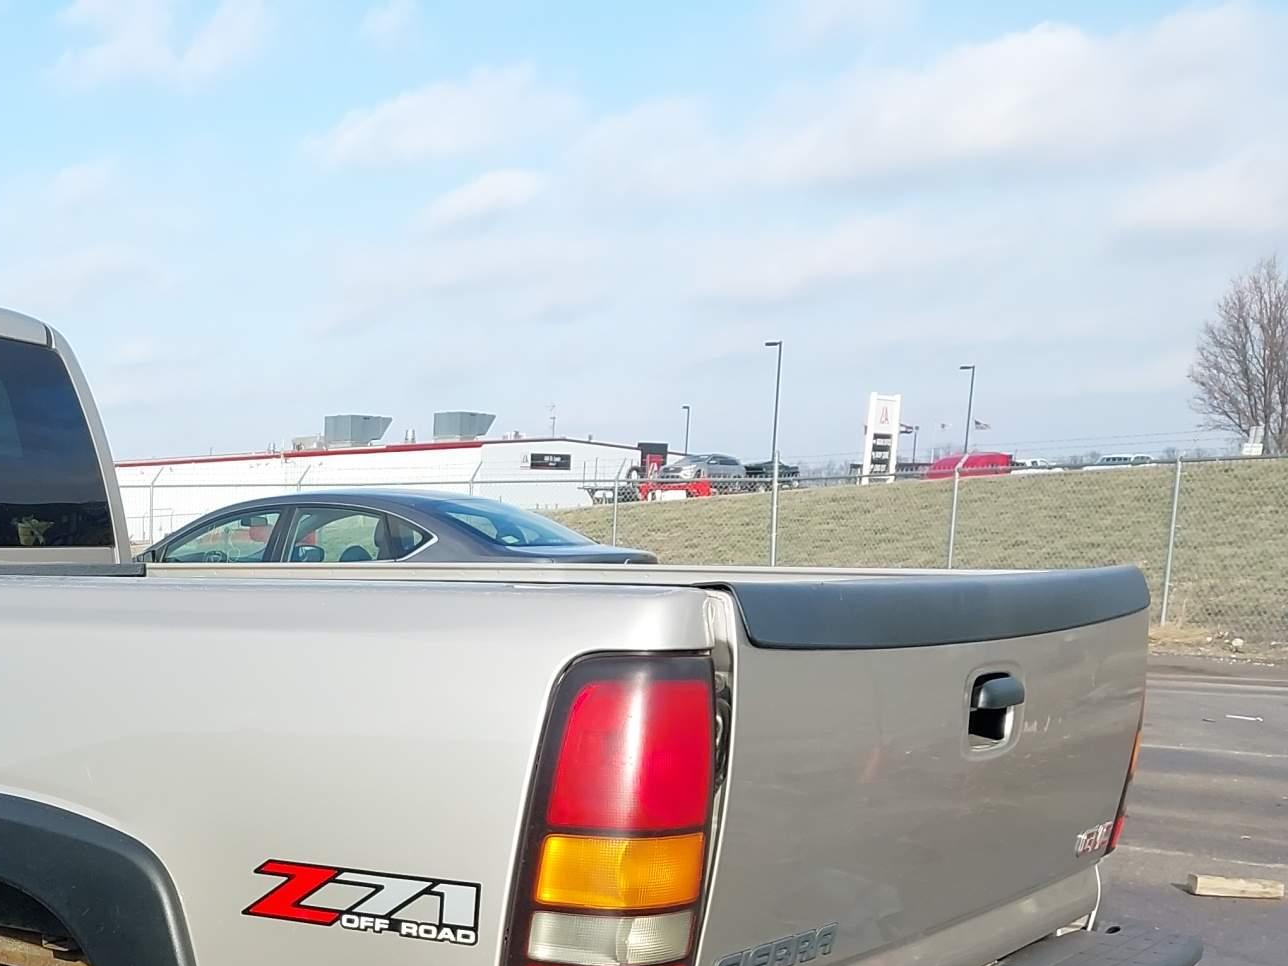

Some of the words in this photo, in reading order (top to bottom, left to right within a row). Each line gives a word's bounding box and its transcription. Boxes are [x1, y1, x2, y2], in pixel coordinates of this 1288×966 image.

[241, 858, 481, 929] Z71
[339, 913, 391, 933] OFF
[400, 921, 477, 944] ROAD
